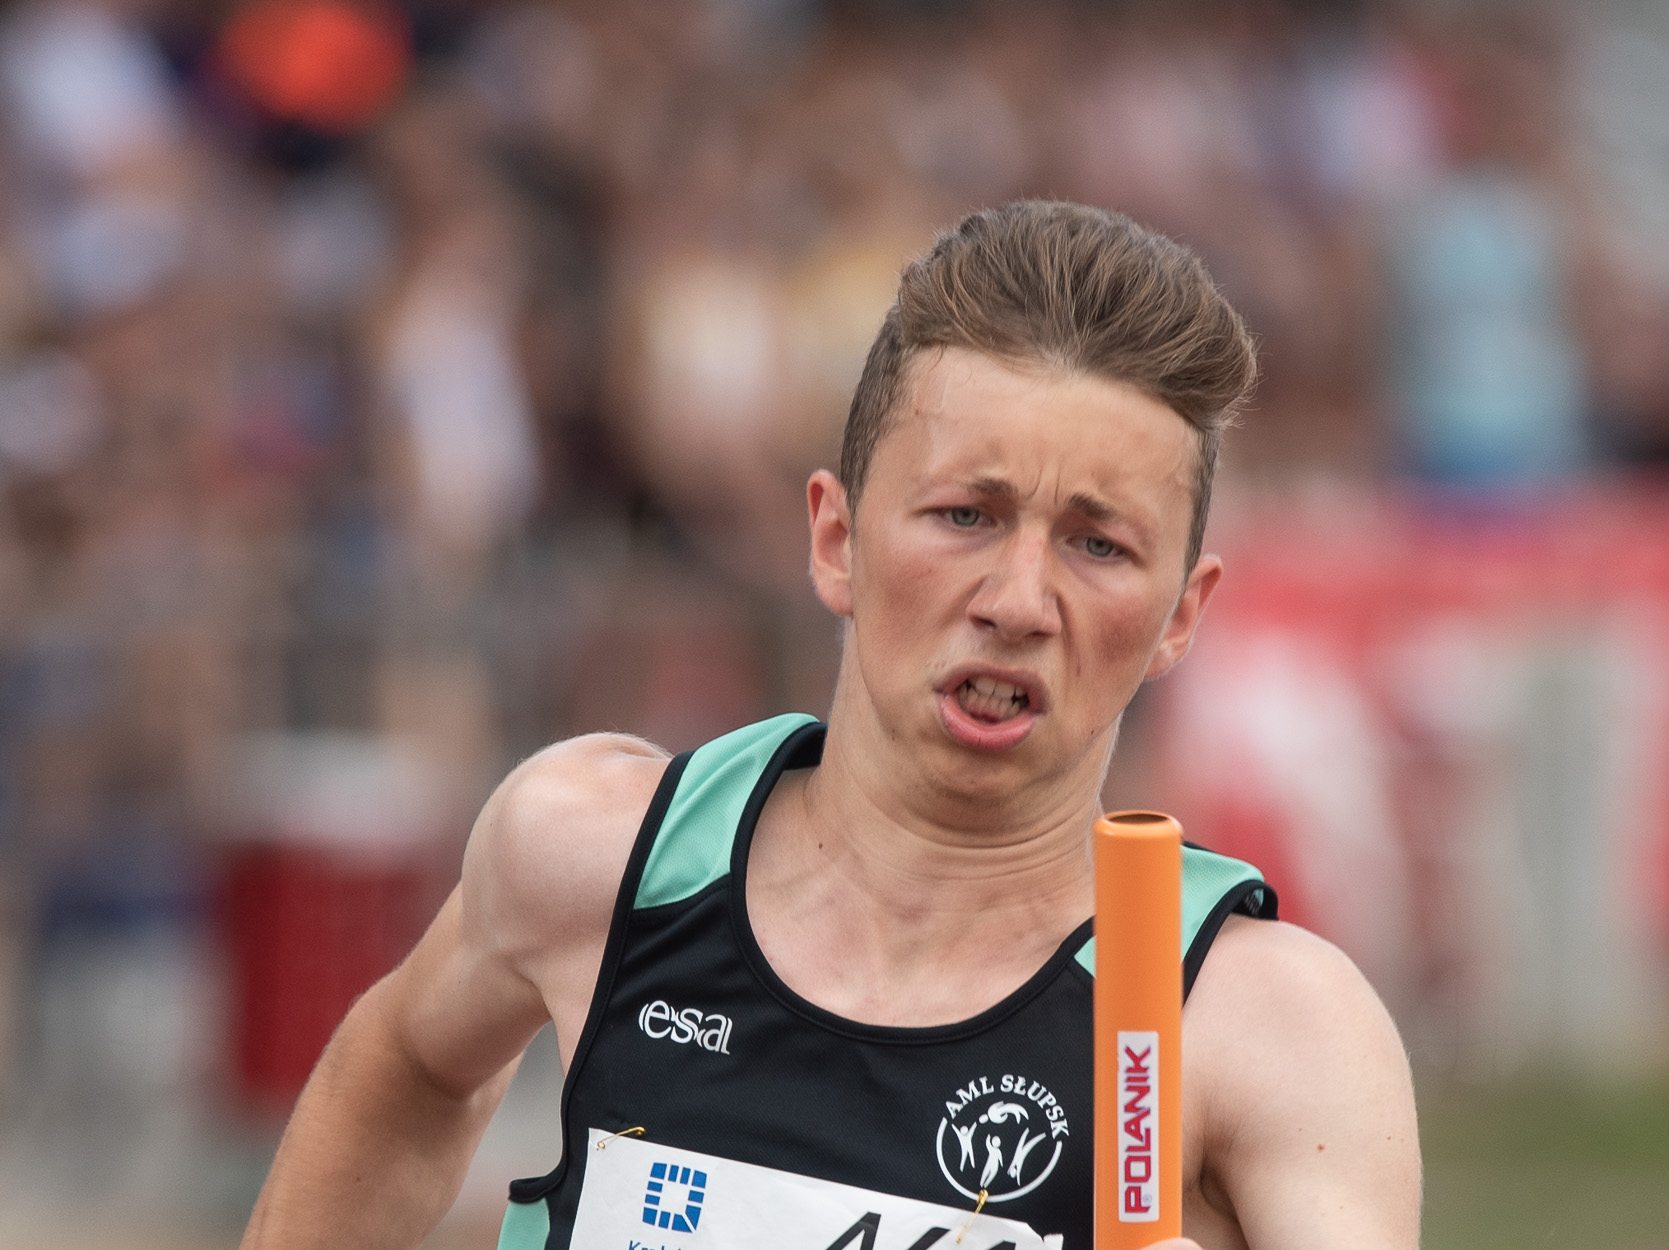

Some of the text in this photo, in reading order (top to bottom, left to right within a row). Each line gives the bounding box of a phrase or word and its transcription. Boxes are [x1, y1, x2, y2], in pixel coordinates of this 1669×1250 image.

[945, 1074, 1070, 1139] AML SŁUPSK
[1124, 1045, 1151, 1214] POLANIK
